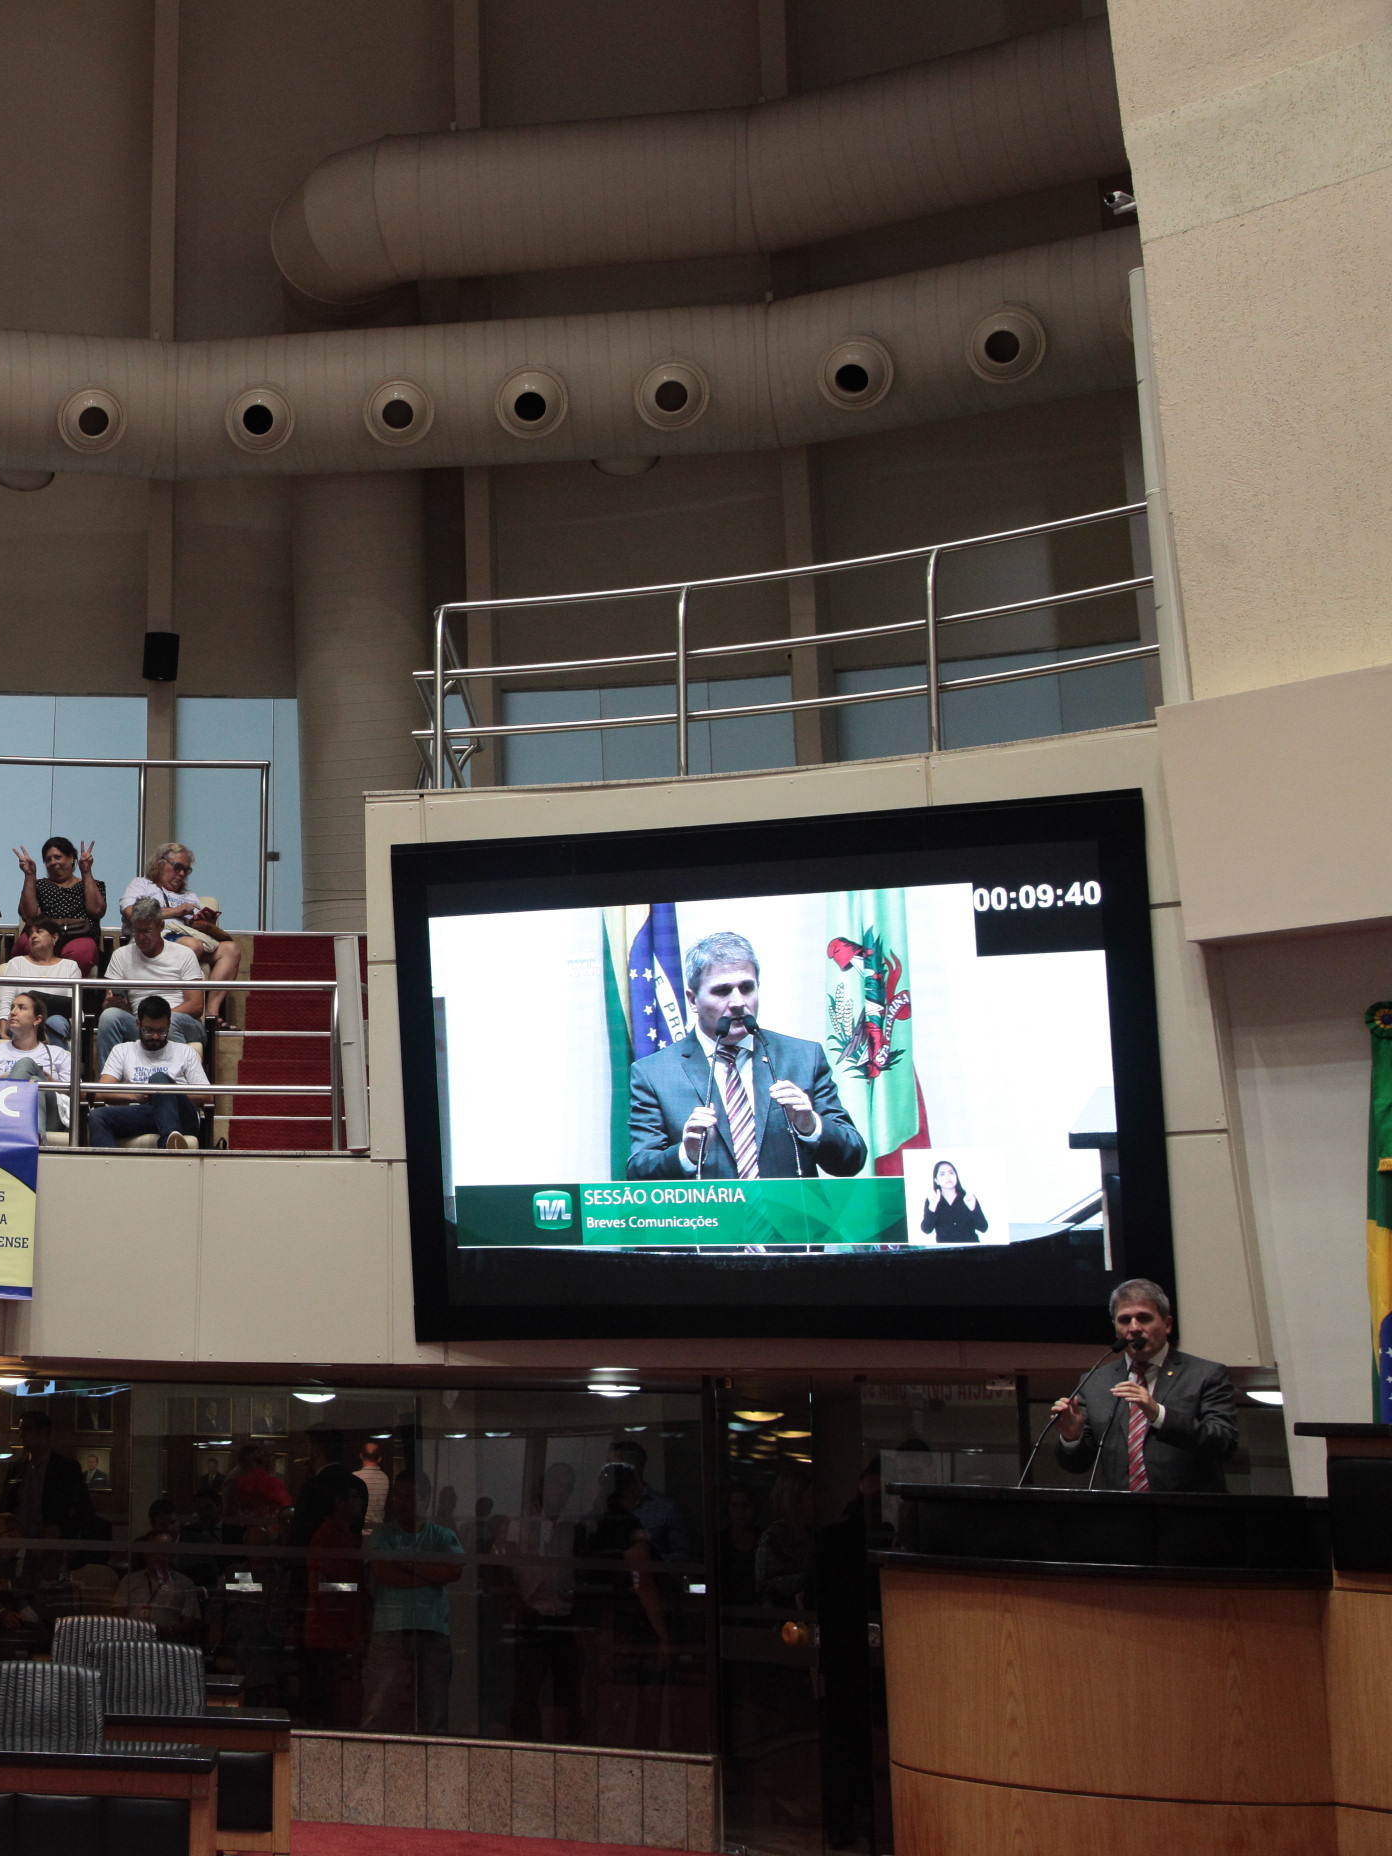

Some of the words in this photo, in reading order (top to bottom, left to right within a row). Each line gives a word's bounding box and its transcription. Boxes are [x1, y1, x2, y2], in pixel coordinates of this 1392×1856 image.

[973, 881, 1101, 911] 00:09:40
[584, 1187, 647, 1205] SESSÃO
[651, 1185, 746, 1204] ORDINÁRIA
[586, 1217, 626, 1228] Breves
[629, 1216, 719, 1230] Comunicações
